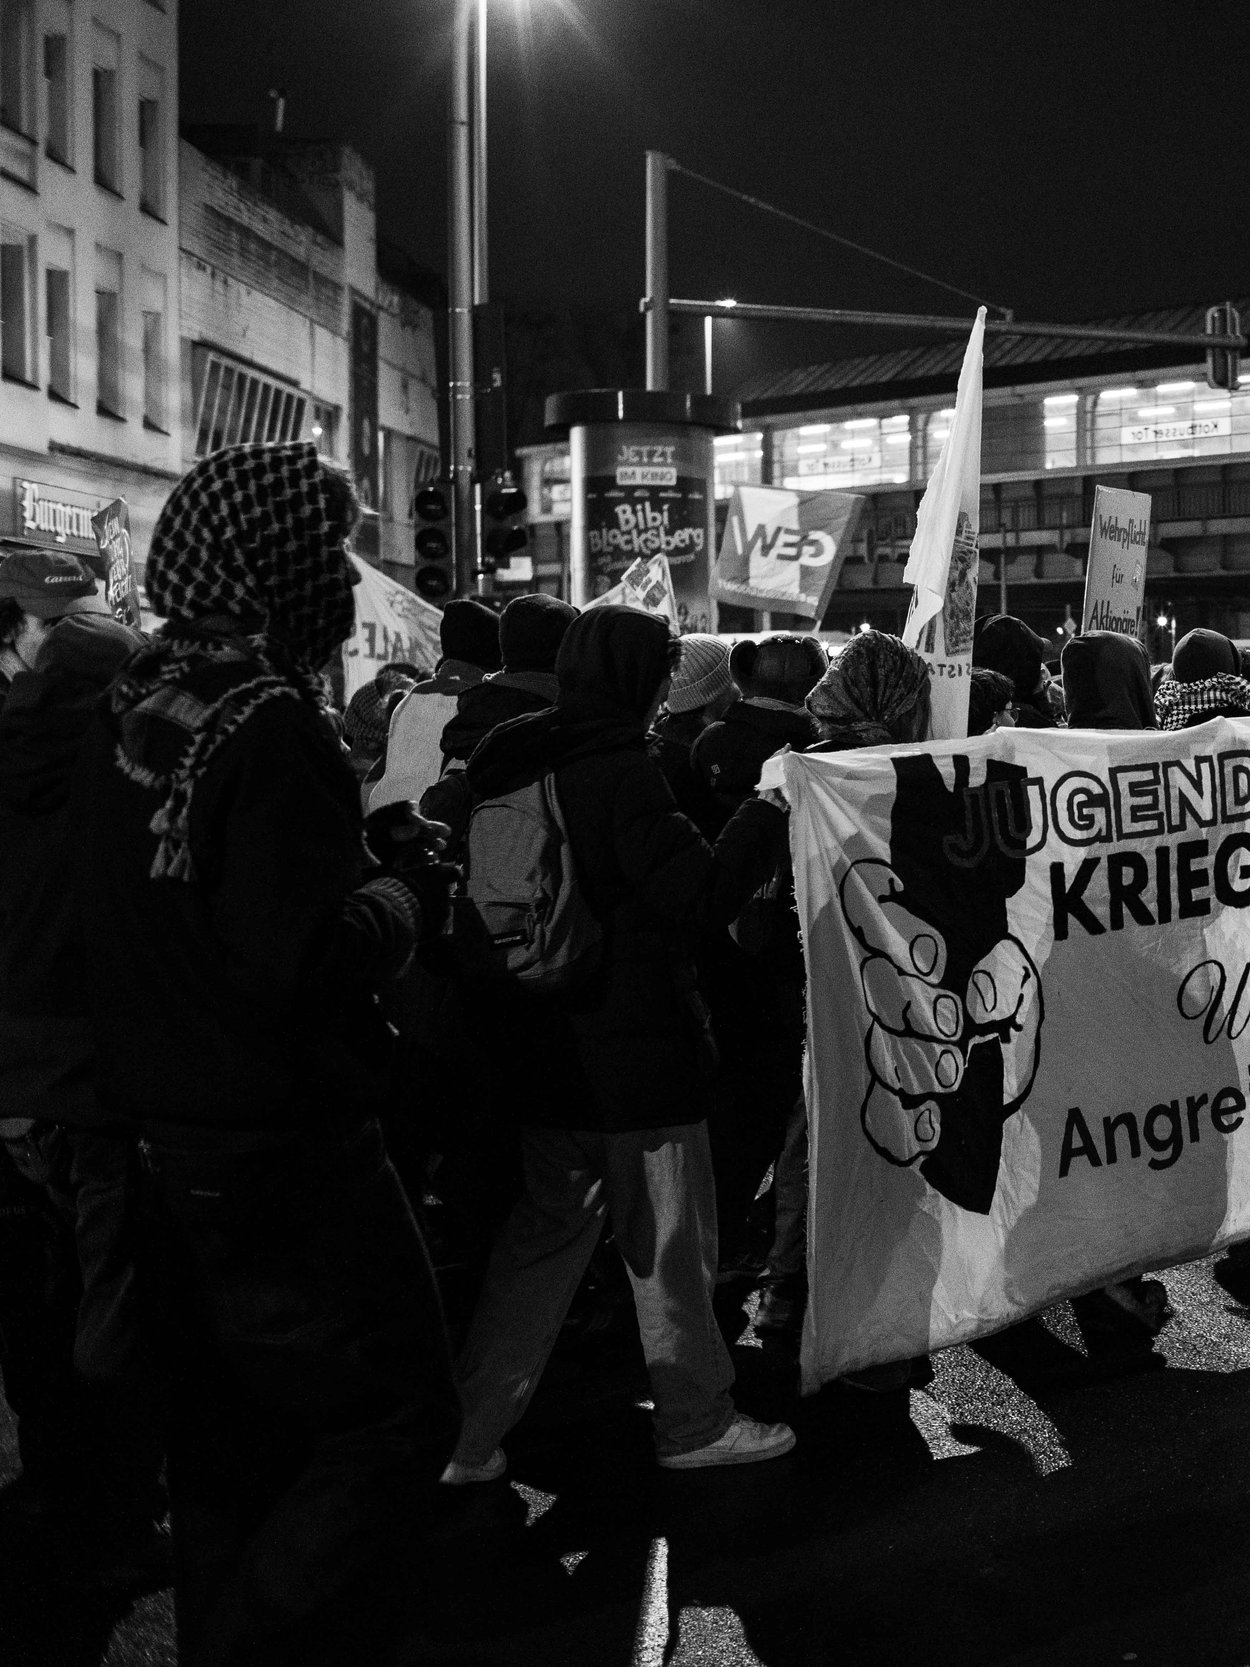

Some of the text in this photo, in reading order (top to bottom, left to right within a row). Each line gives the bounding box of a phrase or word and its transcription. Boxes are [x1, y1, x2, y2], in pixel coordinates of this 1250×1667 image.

[617, 445, 676, 464] JETZT
[619, 470, 674, 482] IM KINO
[614, 501, 670, 532] Bibi
[589, 524, 705, 555] Blocksberg
[1111, 563, 1124, 588] für
